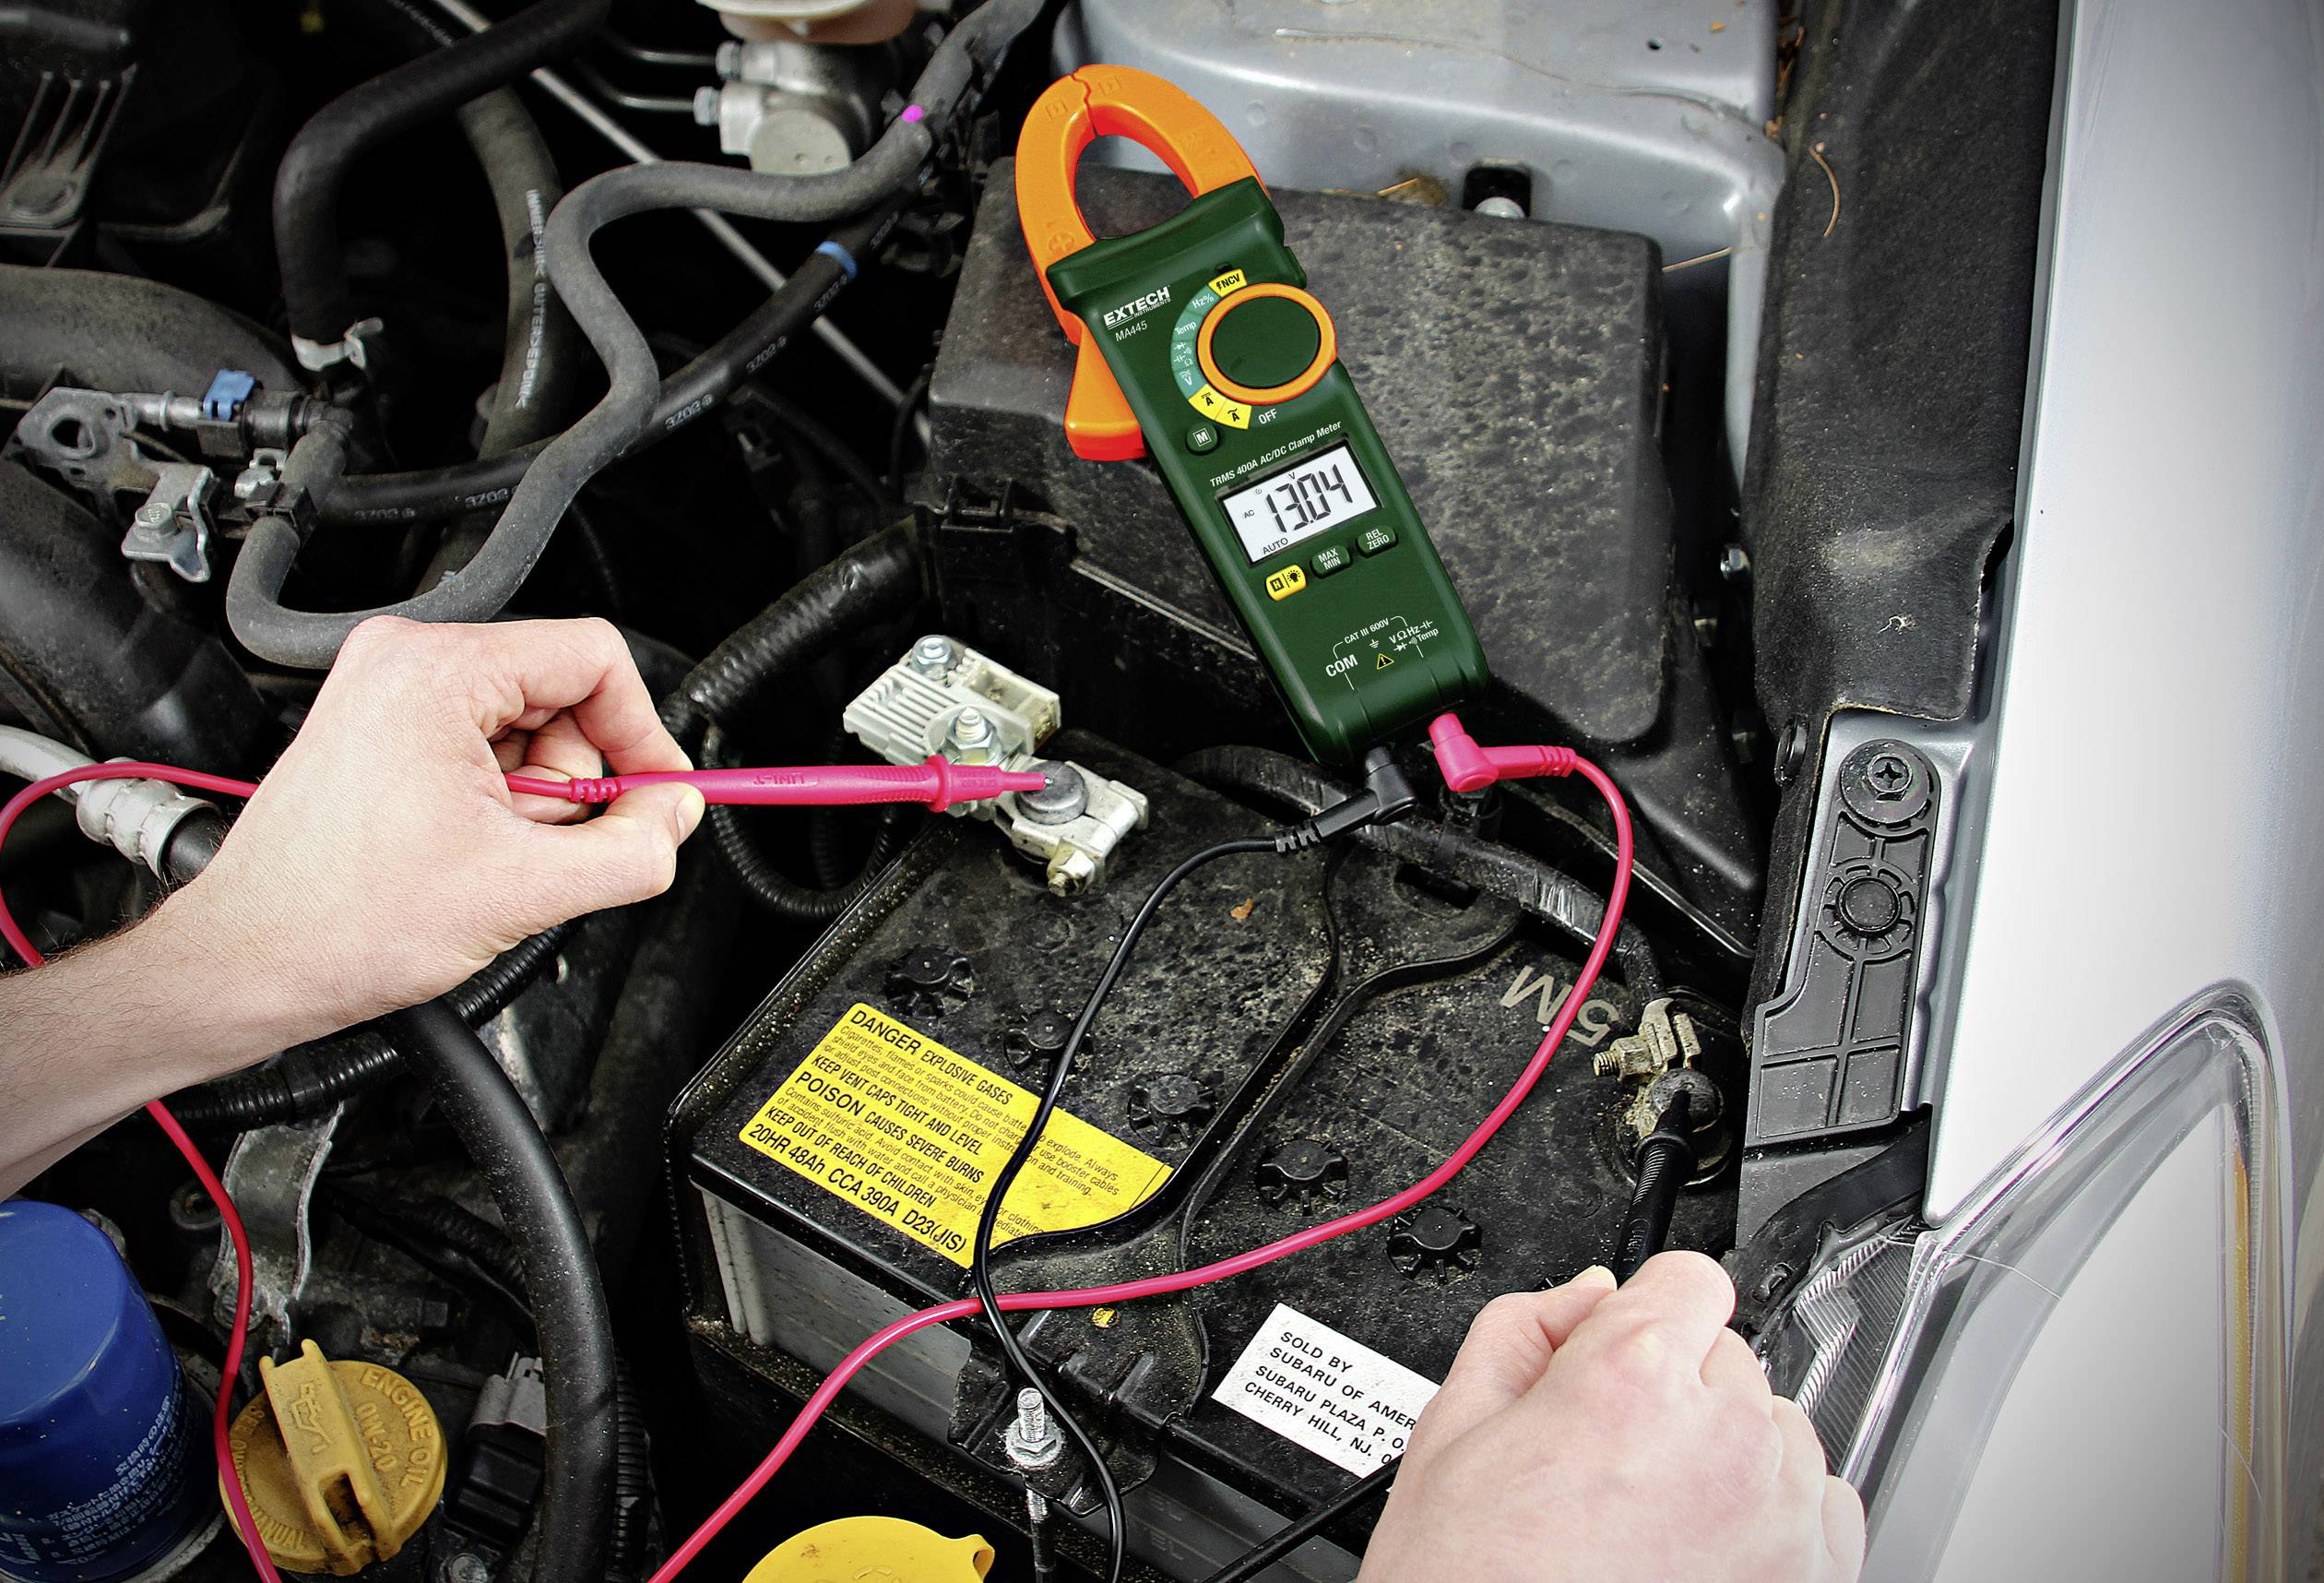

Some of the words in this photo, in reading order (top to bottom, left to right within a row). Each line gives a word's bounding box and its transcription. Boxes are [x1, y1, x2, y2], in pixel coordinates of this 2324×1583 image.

[1192, 293, 1215, 309] Hz%
[1221, 273, 1241, 289] NCV
[1104, 286, 1170, 326] EXTECH
[1133, 297, 1171, 318] INSTRUMENTS
[1116, 320, 1147, 341] MA445
[1174, 319, 1197, 336] Temp
[1258, 409, 1278, 425] OFF
[1210, 470, 1235, 487] TRMS
[1236, 460, 1258, 478] 400A
[1260, 447, 1287, 465] AC/DC
[1288, 434, 1315, 456] Clamp
[1312, 421, 1342, 441] Meter
[1244, 509, 1255, 518] AC
[1262, 537, 1289, 554] AUTO
[1365, 528, 1383, 541] REL
[1366, 535, 1390, 550] ZERO
[1318, 548, 1338, 563] MAX
[1323, 557, 1342, 570] MIN
[1344, 631, 1361, 644] CAT
[1370, 618, 1390, 633] 600V
[1416, 626, 1439, 643] Temp
[1325, 654, 1358, 677] COM
[850, 1010, 920, 1054] DANGER
[920, 1050, 977, 1085] EXPLOSIVE
[976, 1079, 1012, 1104] GASES
[811, 1054, 841, 1074] KEEP
[839, 1068, 869, 1089] VENT
[865, 1084, 896, 1106] CAPS
[895, 1099, 929, 1123] TIGHT
[924, 1117, 951, 1136] AND
[949, 1129, 982, 1155] LEVEL
[824, 1044, 835, 1053] or
[834, 1050, 860, 1067] adjust
[859, 1065, 880, 1077] post
[880, 1075, 929, 1105] connections
[930, 1101, 963, 1123] without
[961, 1120, 991, 1137] proper
[991, 1136, 1038, 1164] instruon
[1038, 1162, 1057, 1174] and
[1056, 1171, 1091, 1196] training.
[831, 1036, 859, 1053] shield
[857, 1049, 878, 1064] eyes
[877, 1061, 896, 1073] and
[895, 1068, 914, 1083] face
[914, 1079, 936, 1095] from
[968, 1109, 982, 1121] Do
[981, 1117, 999, 1129] not
[998, 1126, 1023, 1144] charg
[1038, 1149, 1055, 1161] use
[1055, 1157, 1090, 1178] booster
[1089, 1176, 1119, 1195] cables
[885, 1050, 915, 1070] flames
[914, 1067, 925, 1076] or
[925, 1073, 954, 1091] sparks
[953, 1088, 979, 1104] could
[977, 1101, 1002, 1118] cause
[1002, 1113, 1030, 1131] batte
[1046, 1139, 1081, 1161] explode.
[1084, 1158, 1118, 1181] Always
[785, 1087, 821, 1111] Contains
[820, 1108, 854, 1129] sulfuric
[874, 1137, 901, 1155] Avoid
[900, 1152, 933, 1173] contact
[933, 1170, 954, 1185] with
[795, 1071, 865, 1115] POISON
[864, 1111, 907, 1140] CAUSES
[906, 1134, 947, 1162] SEVERE
[945, 1156, 983, 1183] BURNS
[765, 1106, 794, 1125] KEEP
[791, 1121, 817, 1139] OUT
[813, 1134, 833, 1148] OF
[829, 1142, 868, 1169] REACH
[865, 1162, 883, 1176] OF
[881, 1171, 936, 1208] CHILDREN
[777, 1097, 789, 1105] of
[788, 1103, 824, 1125] accident
[824, 1121, 846, 1138] flush
[846, 1135, 866, 1150] with
[867, 1148, 893, 1164] water
[893, 1162, 912, 1174] and
[910, 1172, 929, 1184] call
[934, 1185, 979, 1211] physician
[748, 1124, 790, 1153] 20HR
[788, 1146, 824, 1173] 48Ah
[828, 1168, 862, 1196] CCA
[860, 1186, 899, 1216] 390A
[902, 1208, 966, 1252] D23(JIS)
[1280, 1331, 1322, 1358] SOLD
[1328, 1356, 1352, 1372] BY
[1255, 1365, 1316, 1401] SUBARU
[1320, 1399, 1365, 1430] PLAZA
[1270, 1347, 1336, 1386] SUBARU
[1342, 1385, 1364, 1399] OF
[1369, 1400, 1417, 1430] AMER
[354, 1402, 397, 1471] 0W-20
[361, 1367, 432, 1441] ENGINE
[399, 1446, 432, 1487] OIL
[1245, 1382, 1303, 1415] CHERRY
[1308, 1414, 1341, 1441] HILL,
[1349, 1436, 1371, 1456] NJ.
